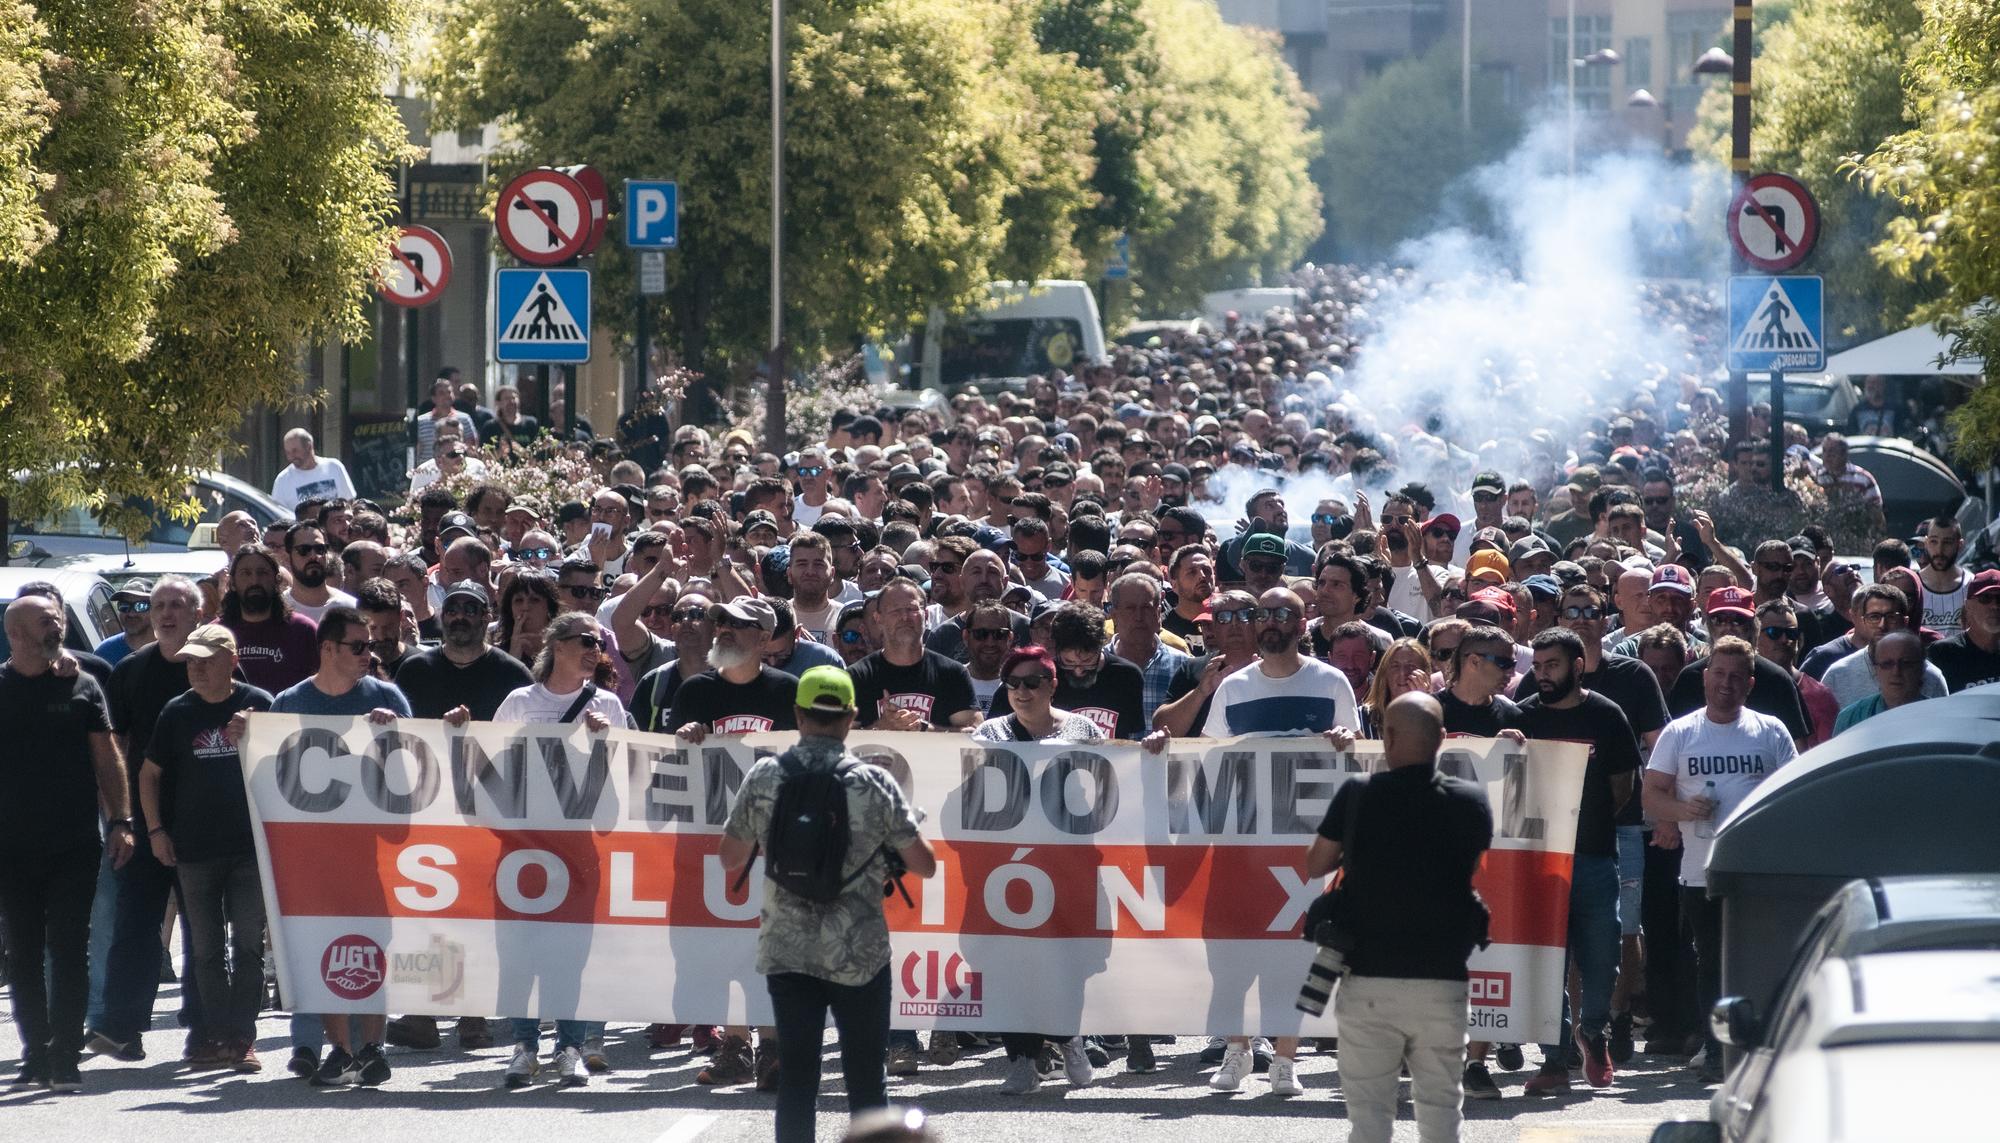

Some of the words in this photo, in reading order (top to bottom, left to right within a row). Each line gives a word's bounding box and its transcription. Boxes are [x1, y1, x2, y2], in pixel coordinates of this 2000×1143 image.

[636, 189, 668, 240] P
[238, 645, 275, 656] rtisano
[724, 716, 768, 733] METAL
[1688, 755, 1764, 776] BUDDHA
[960, 748, 1120, 835] DO
[393, 844, 1166, 931] SOLUIÓN
[329, 945, 378, 971] UGT
[394, 954, 442, 971] MCA
[901, 951, 982, 1001] CIG
[901, 1003, 981, 1016] INDUSTRIA
[1468, 1008, 1509, 1028] stria
